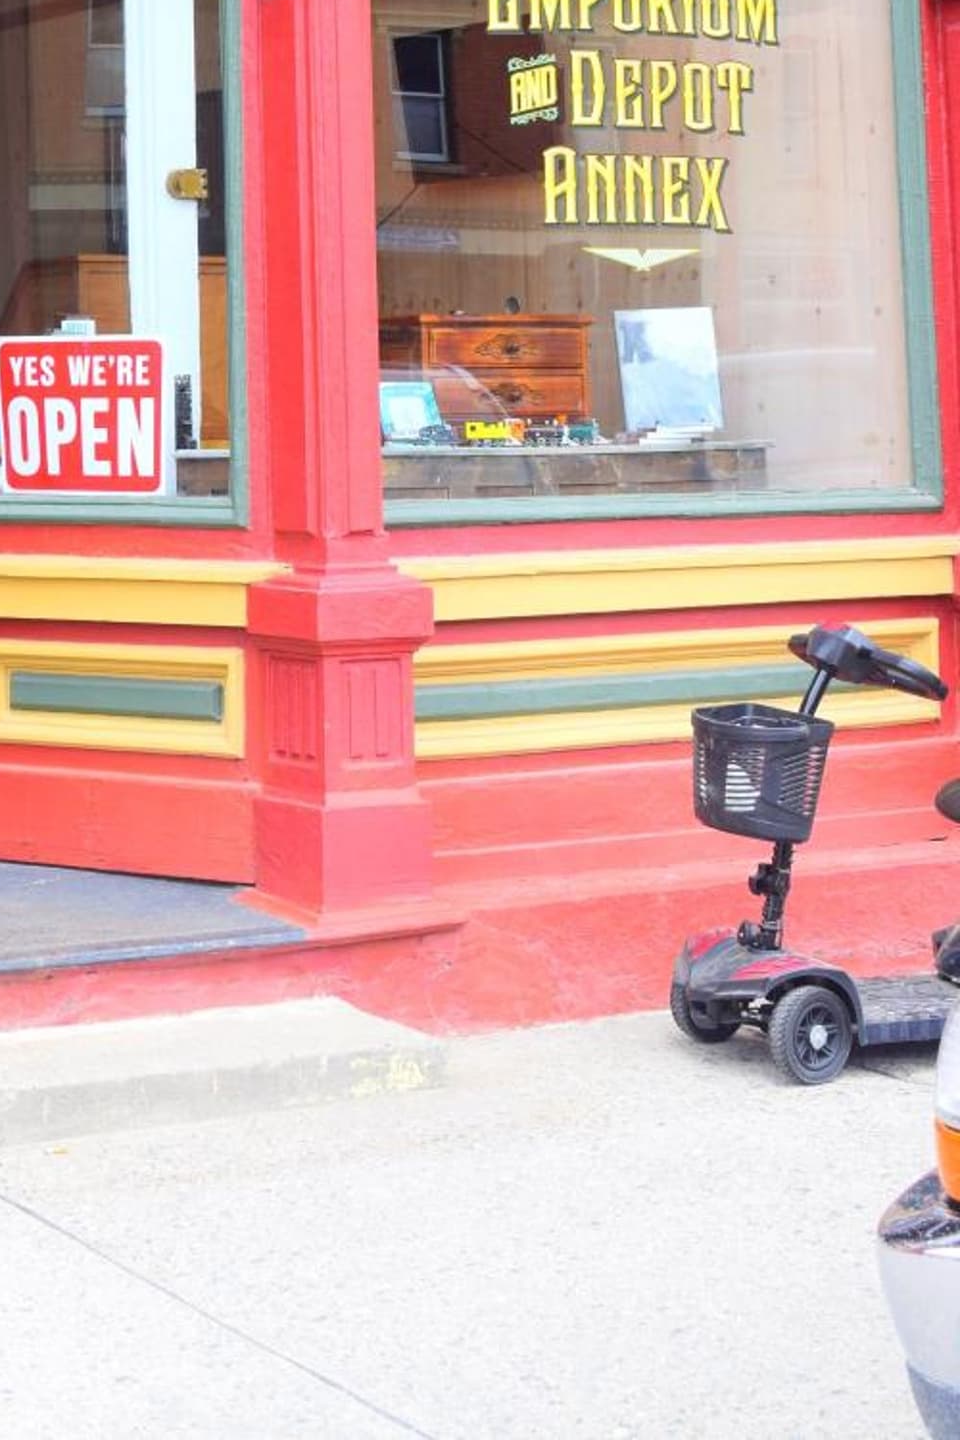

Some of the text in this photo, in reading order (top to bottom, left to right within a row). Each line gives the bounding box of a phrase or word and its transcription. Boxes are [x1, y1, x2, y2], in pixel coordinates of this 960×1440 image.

[509, 50, 752, 134] AND DEPOT
[542, 146, 730, 232] ANNEX
[9, 355, 150, 386] YES WE'RE
[7, 396, 155, 477] OPEN
